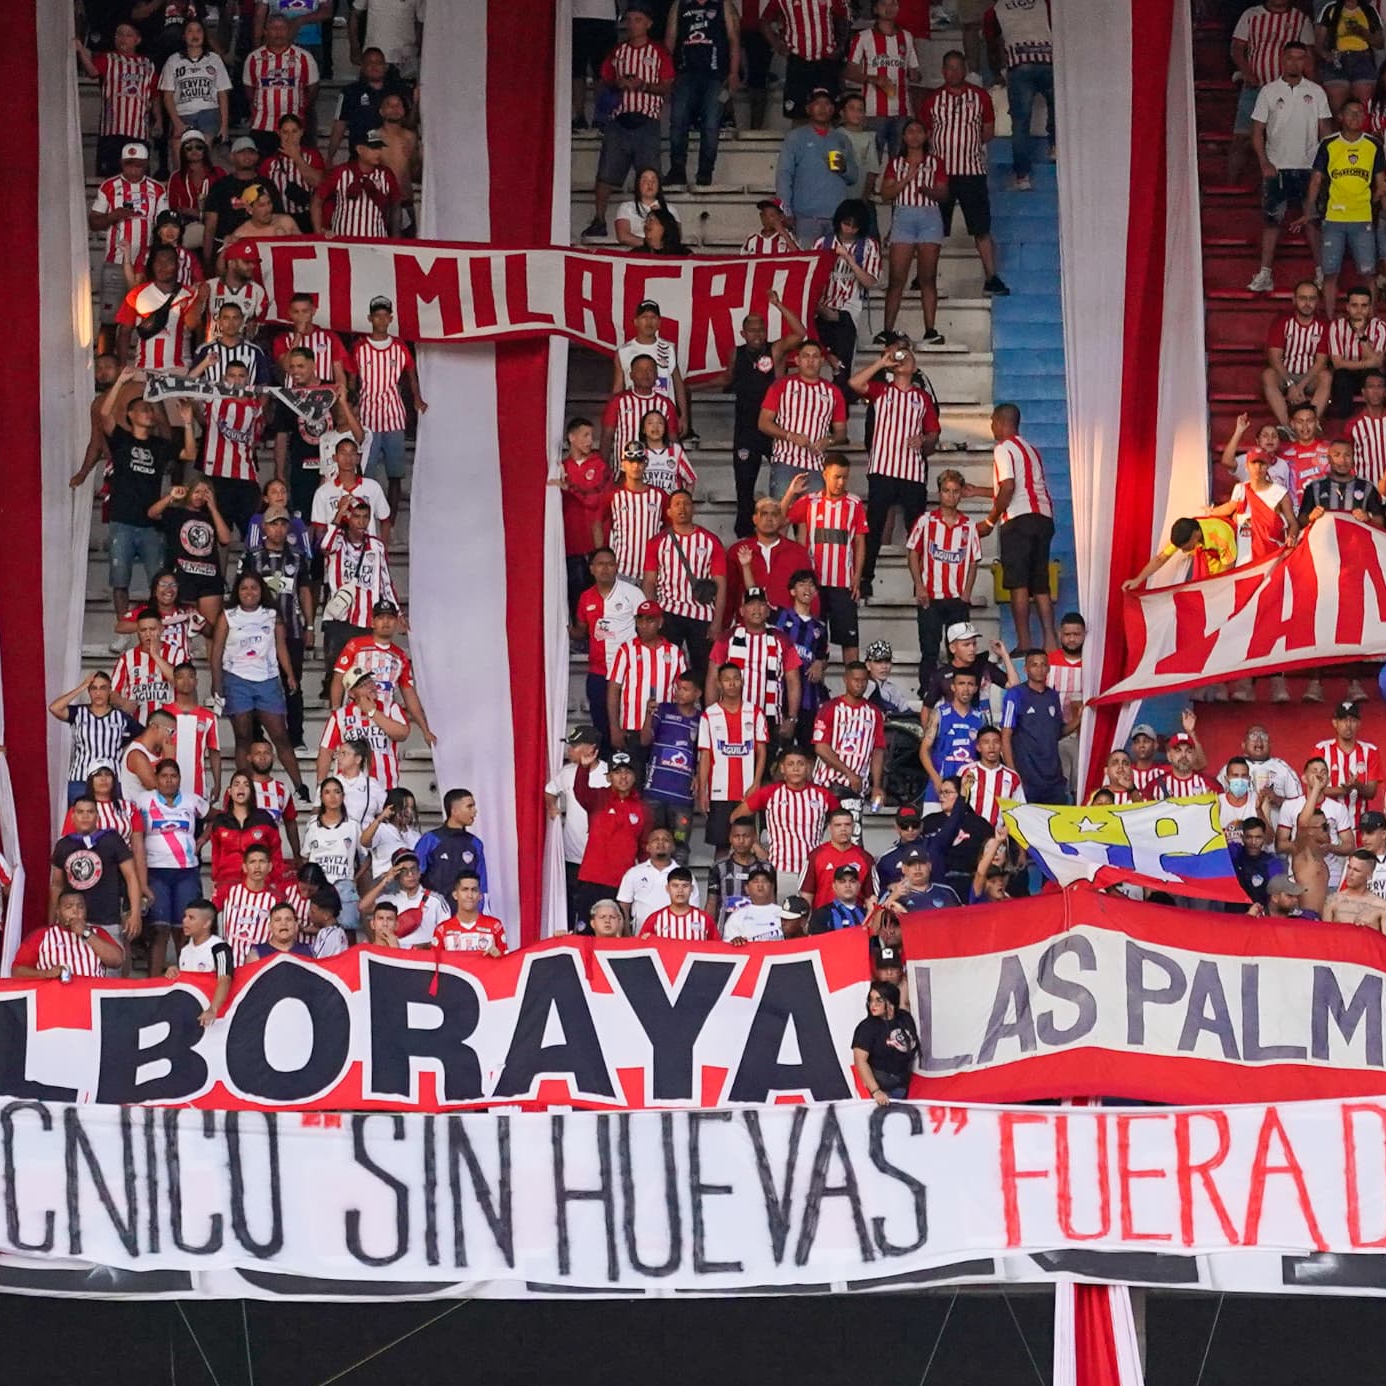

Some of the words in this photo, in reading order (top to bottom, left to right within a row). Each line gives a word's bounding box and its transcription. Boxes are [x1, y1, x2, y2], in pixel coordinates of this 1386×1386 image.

[395, 252, 820, 383] MILAGRO
[913, 932, 1099, 1073] LAS
[998, 1105, 1329, 1251] FUERA
